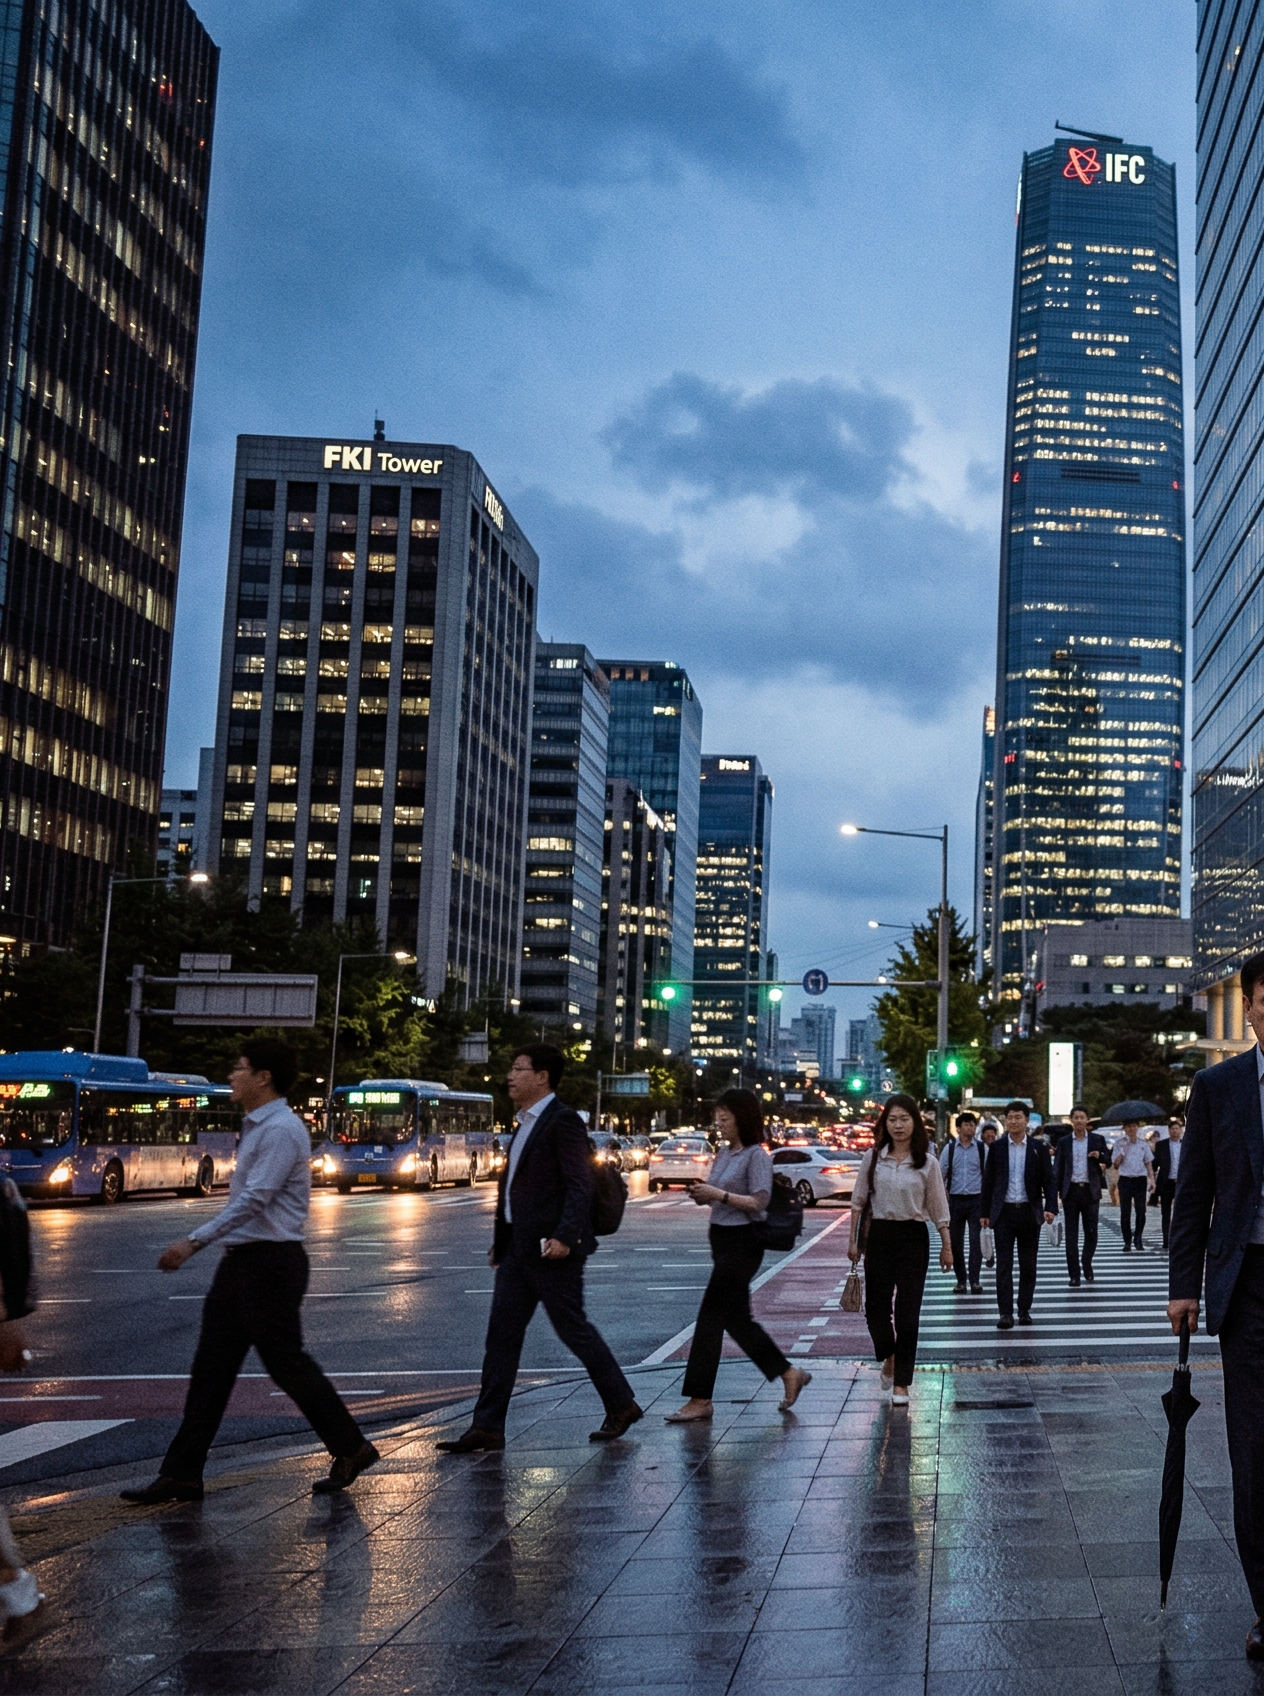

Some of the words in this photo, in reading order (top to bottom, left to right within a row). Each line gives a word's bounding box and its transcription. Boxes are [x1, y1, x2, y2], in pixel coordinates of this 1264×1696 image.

[1105, 153, 1146, 185] IFC
[323, 445, 372, 471] FKI
[377, 452, 443, 475] Tower
